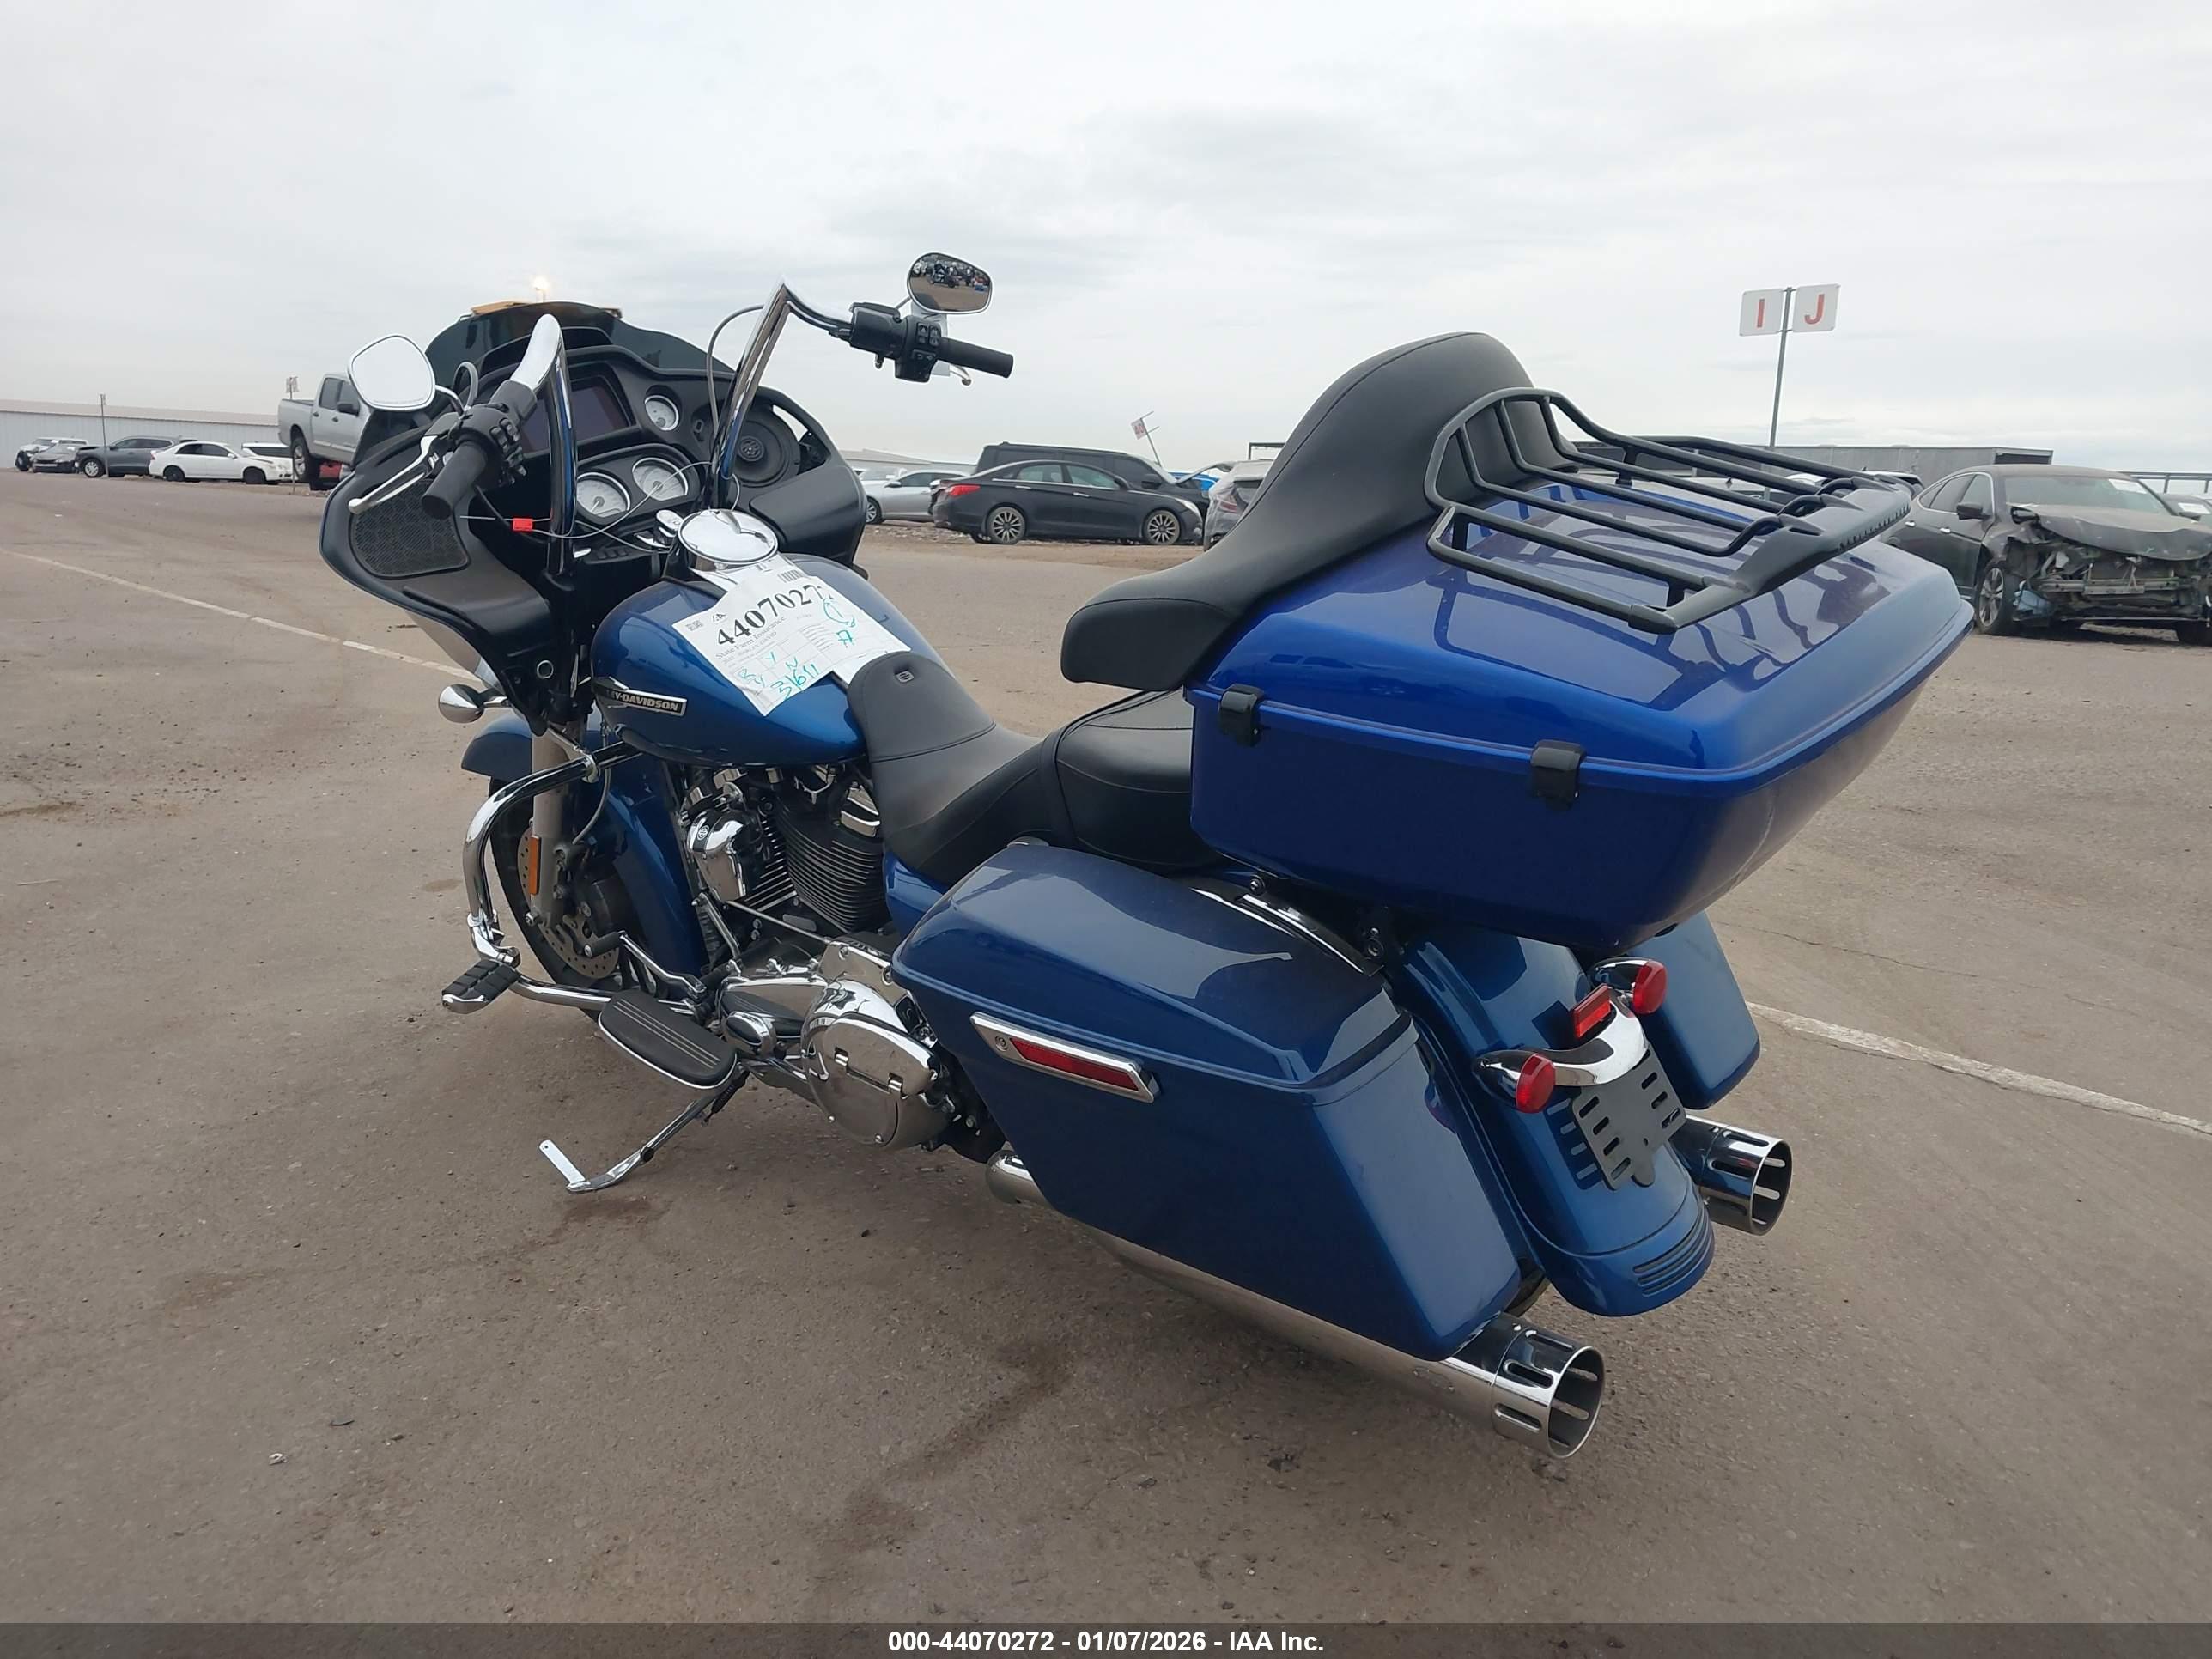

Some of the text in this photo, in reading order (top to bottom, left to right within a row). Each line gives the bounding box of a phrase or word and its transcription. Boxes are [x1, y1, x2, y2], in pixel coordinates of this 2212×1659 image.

[1757, 298, 1765, 328] I
[1804, 294, 1826, 325] J
[753, 616, 787, 640] Insurance
